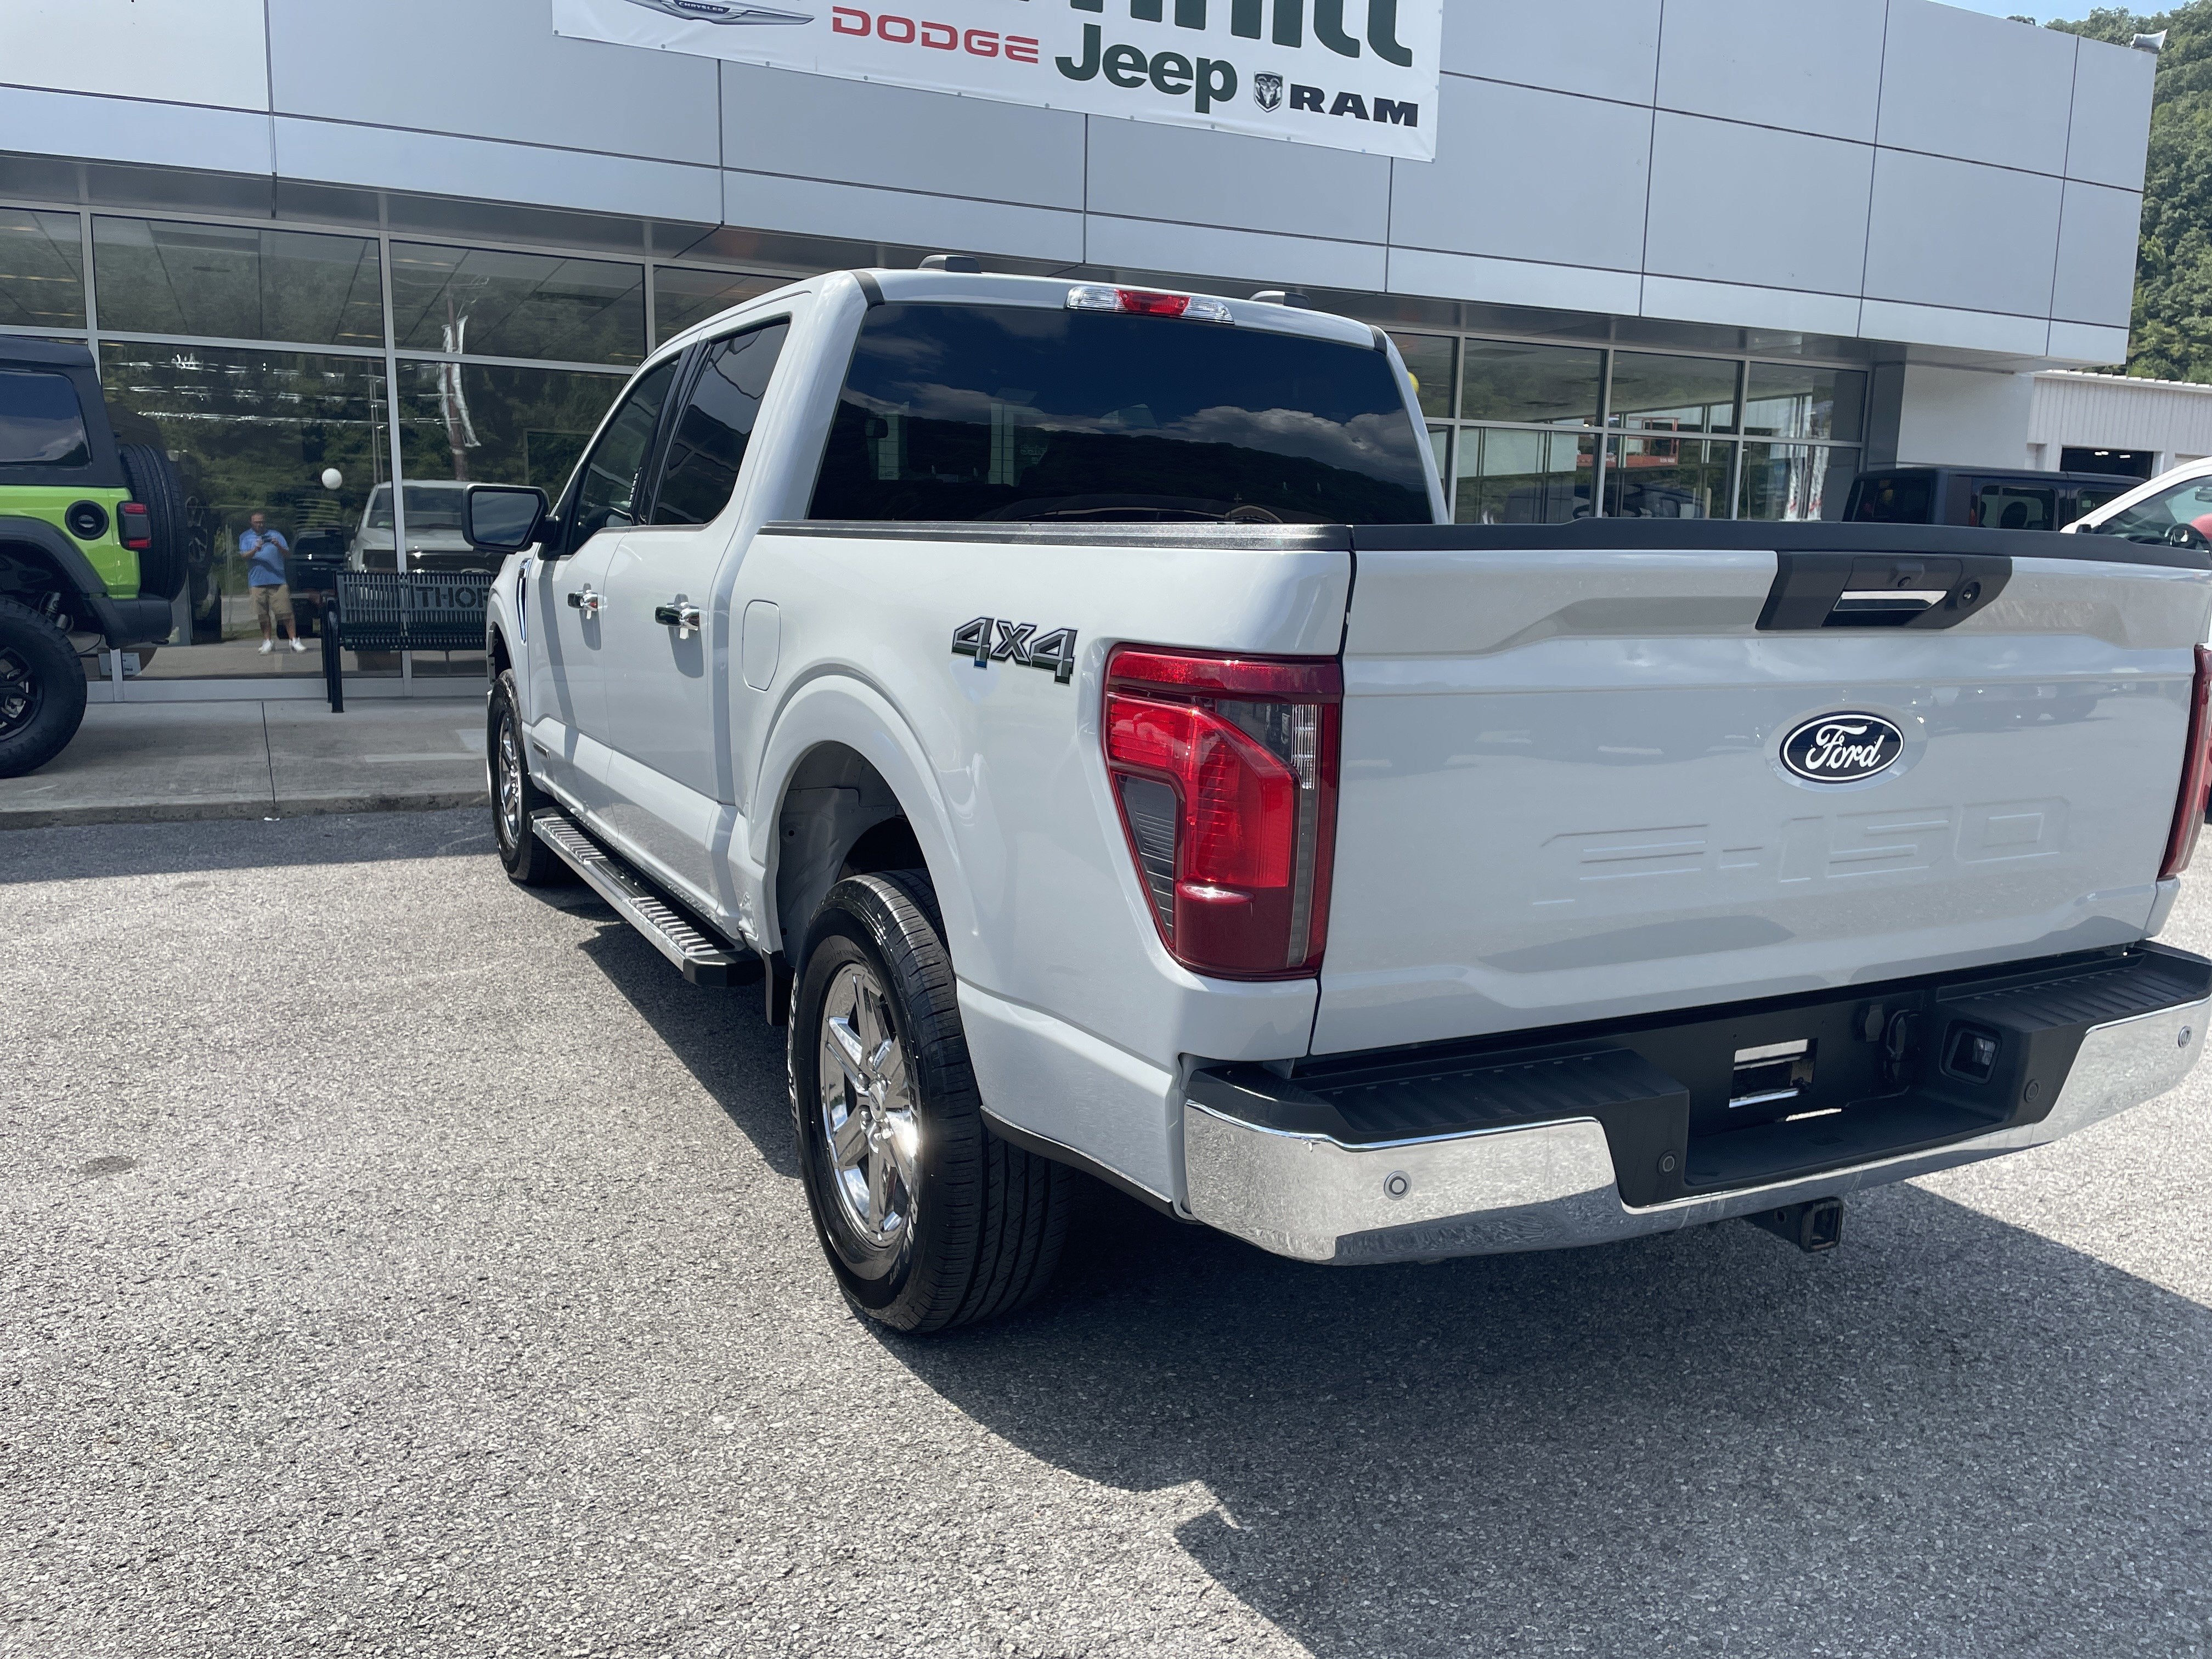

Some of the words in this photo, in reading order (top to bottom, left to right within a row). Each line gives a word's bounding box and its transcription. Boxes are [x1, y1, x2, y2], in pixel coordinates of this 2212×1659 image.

[678, 1, 724, 12] CHRYSLER
[832, 6, 1039, 64] DODGE
[1055, 23, 1238, 114] Jeep
[1290, 83, 1418, 127] RAM
[1805, 724, 1884, 770] Ford
[1532, 795, 2071, 904] F-150
